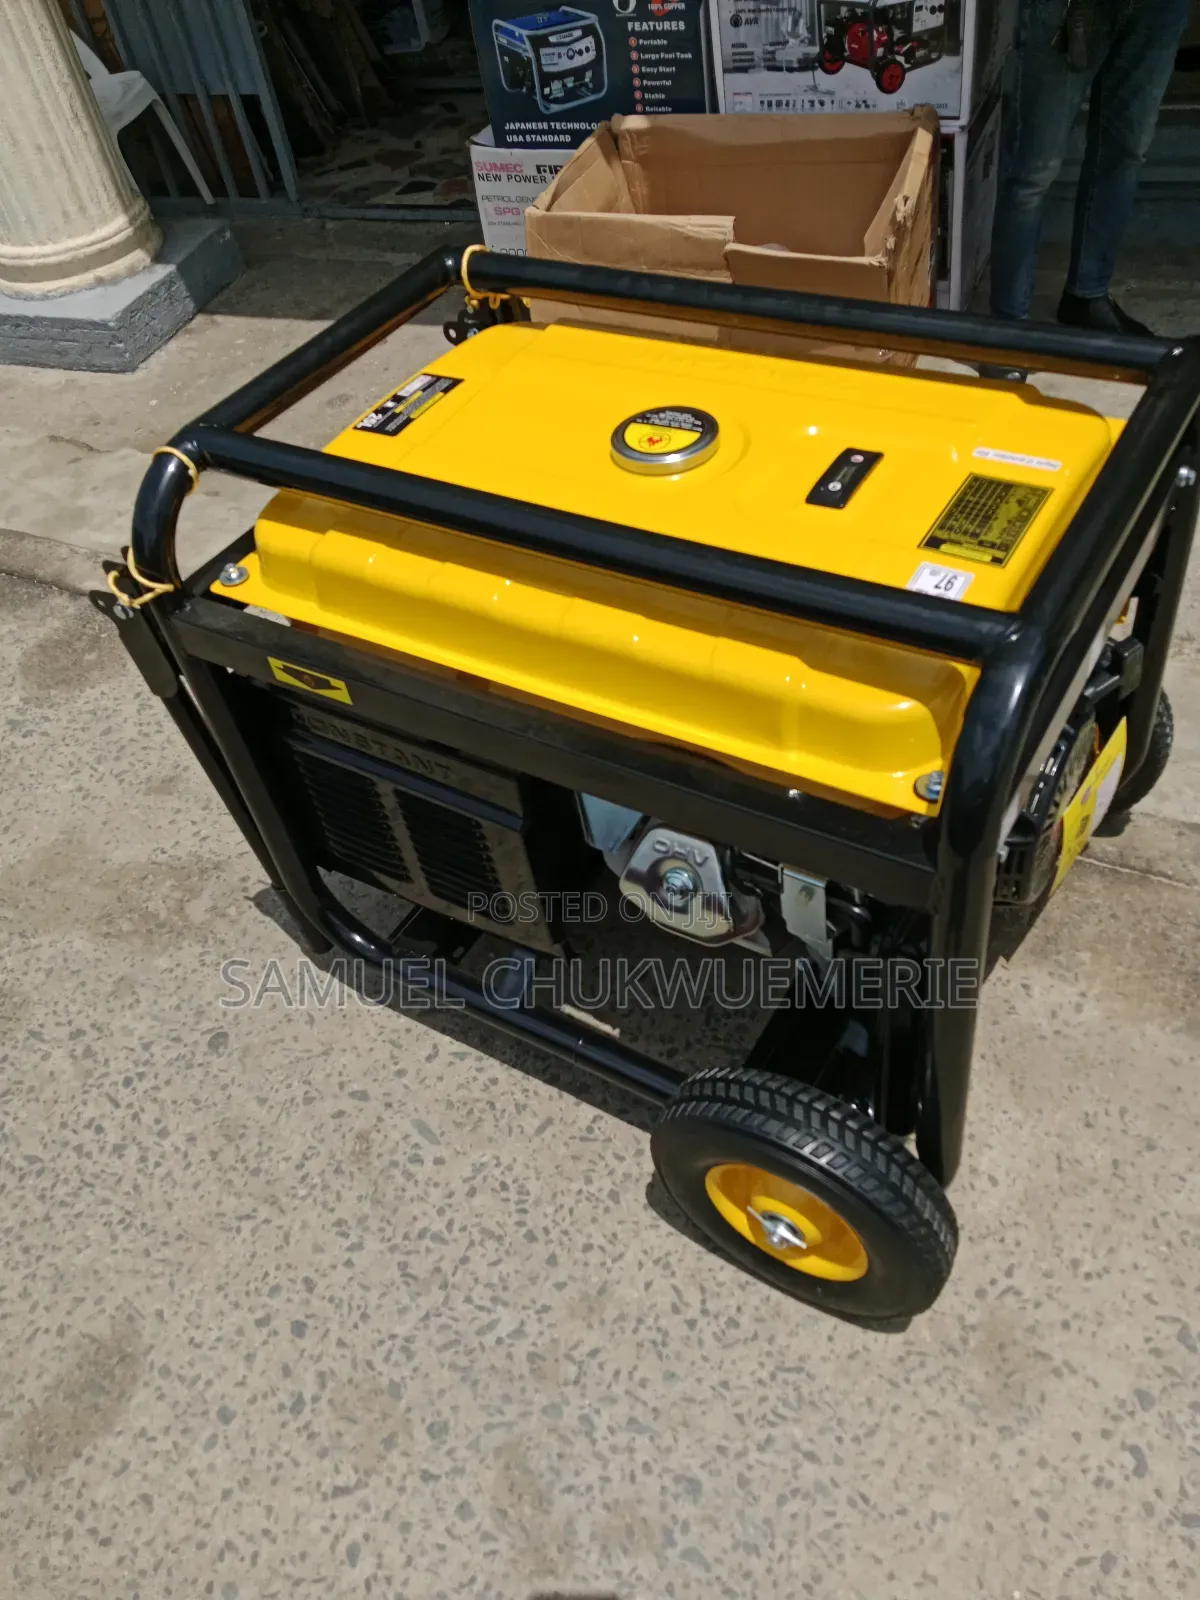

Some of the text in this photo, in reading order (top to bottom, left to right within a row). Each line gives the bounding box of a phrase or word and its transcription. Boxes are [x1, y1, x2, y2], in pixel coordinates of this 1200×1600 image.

[627, 21, 686, 32] FEATURES
[640, 52, 660, 60] Large
[641, 66, 657, 74] Easy
[645, 105, 672, 113] Reliable
[505, 122, 601, 130] JAPANESE TECHNOLO
[506, 134, 571, 143] USA STANDARD
[475, 161, 524, 173] SUMEC
[477, 173, 548, 184] NEW POWER
[481, 195, 515, 203] PETROL
[494, 206, 520, 216] SPG
[652, 837, 710, 868] OHV
